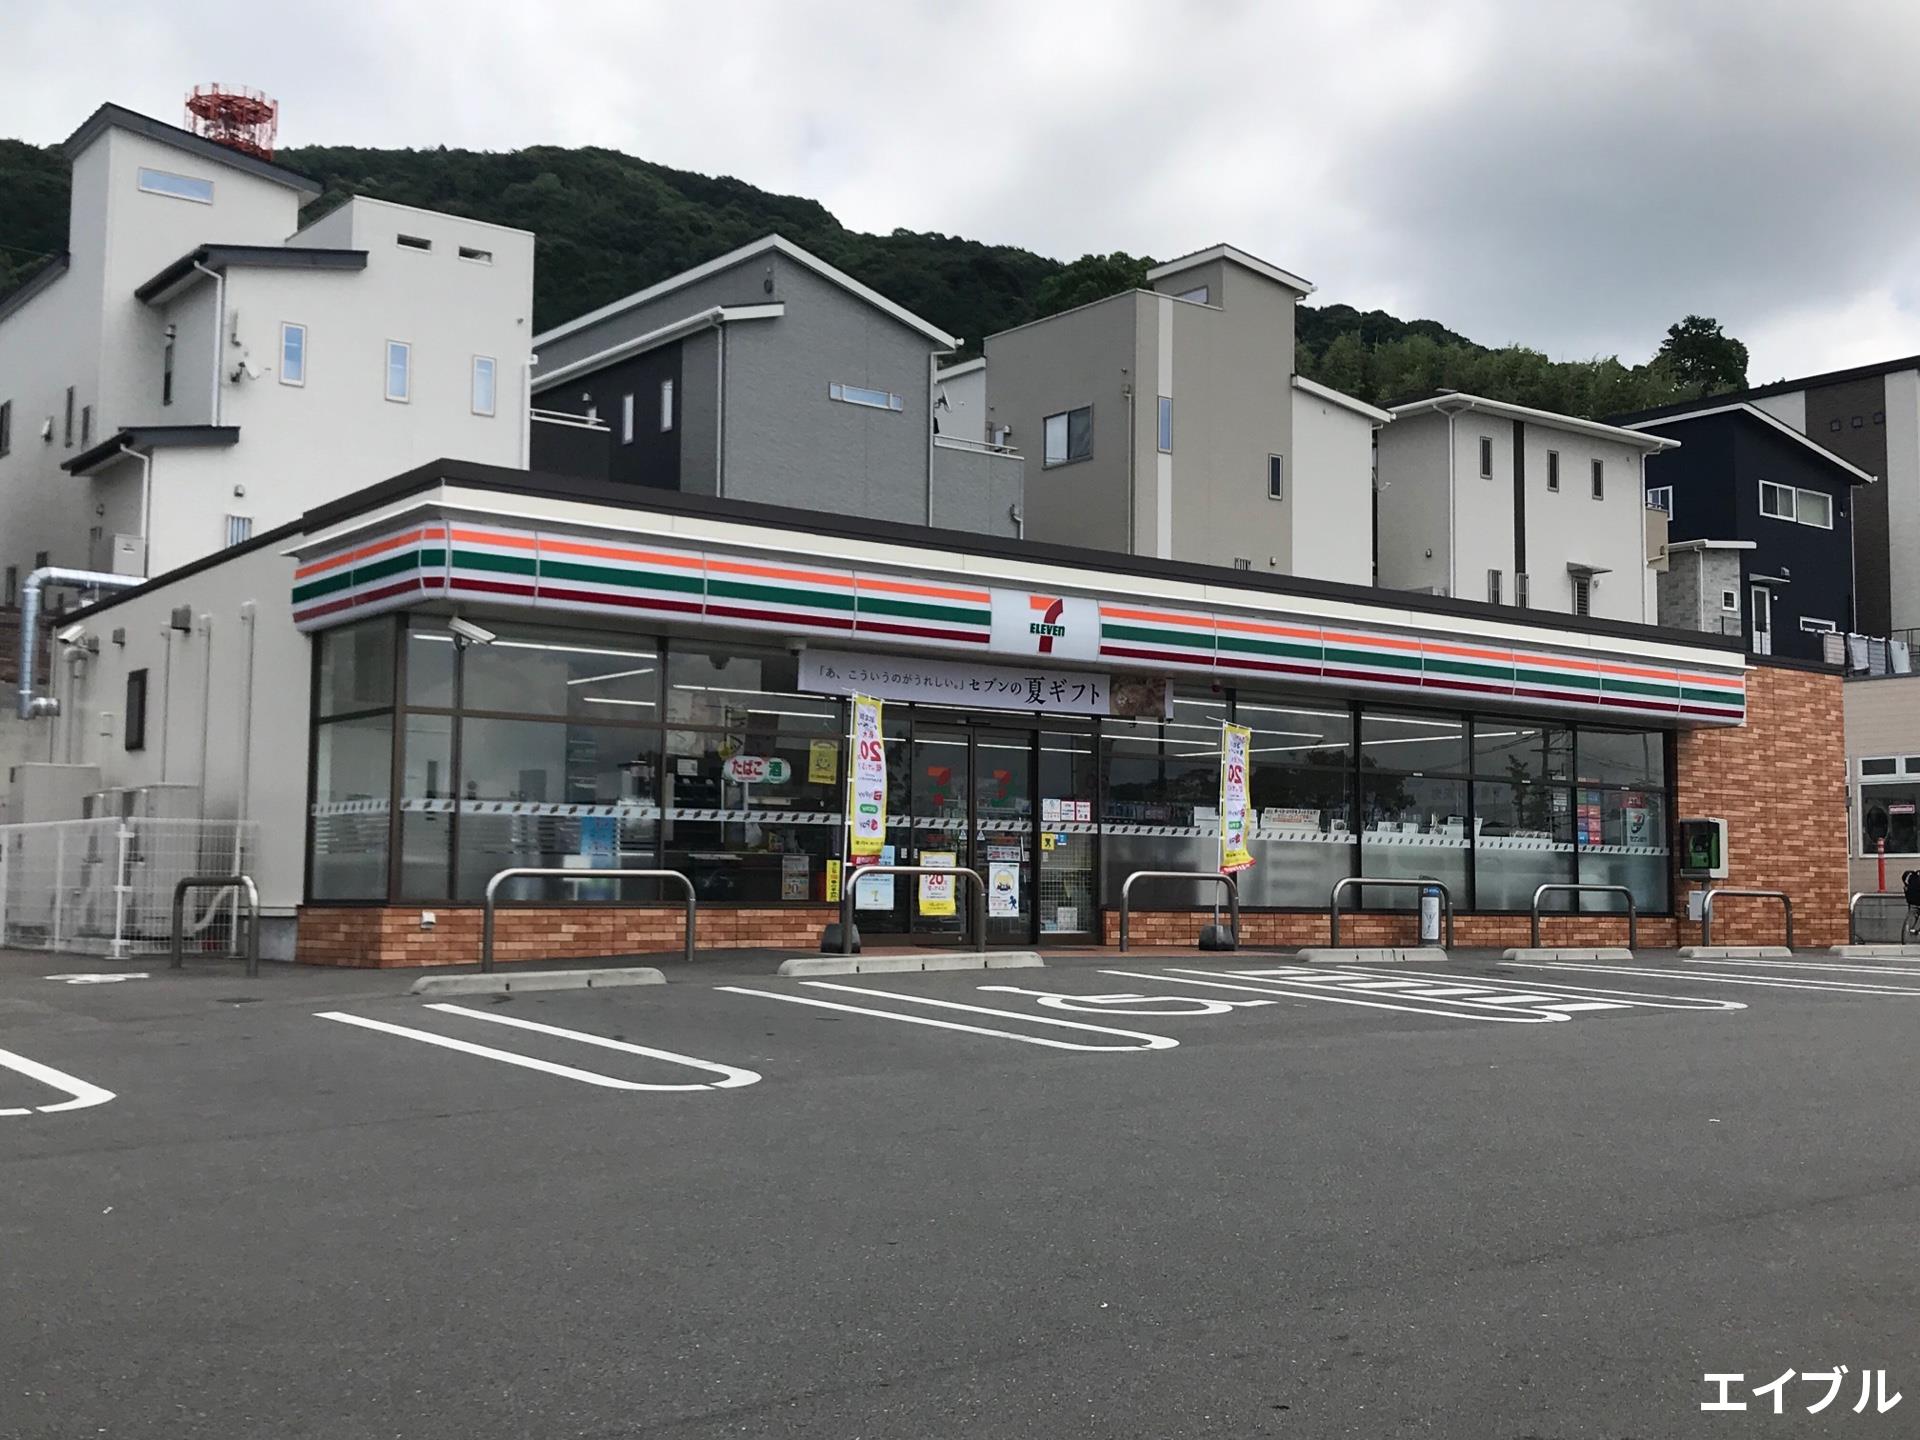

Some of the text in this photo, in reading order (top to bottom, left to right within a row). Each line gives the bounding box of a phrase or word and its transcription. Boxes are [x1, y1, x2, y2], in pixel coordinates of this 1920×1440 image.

[1030, 595, 1063, 653] 7
[969, 676, 1100, 706] セブンの夏ギフト
[732, 760, 763, 776] たばこ
